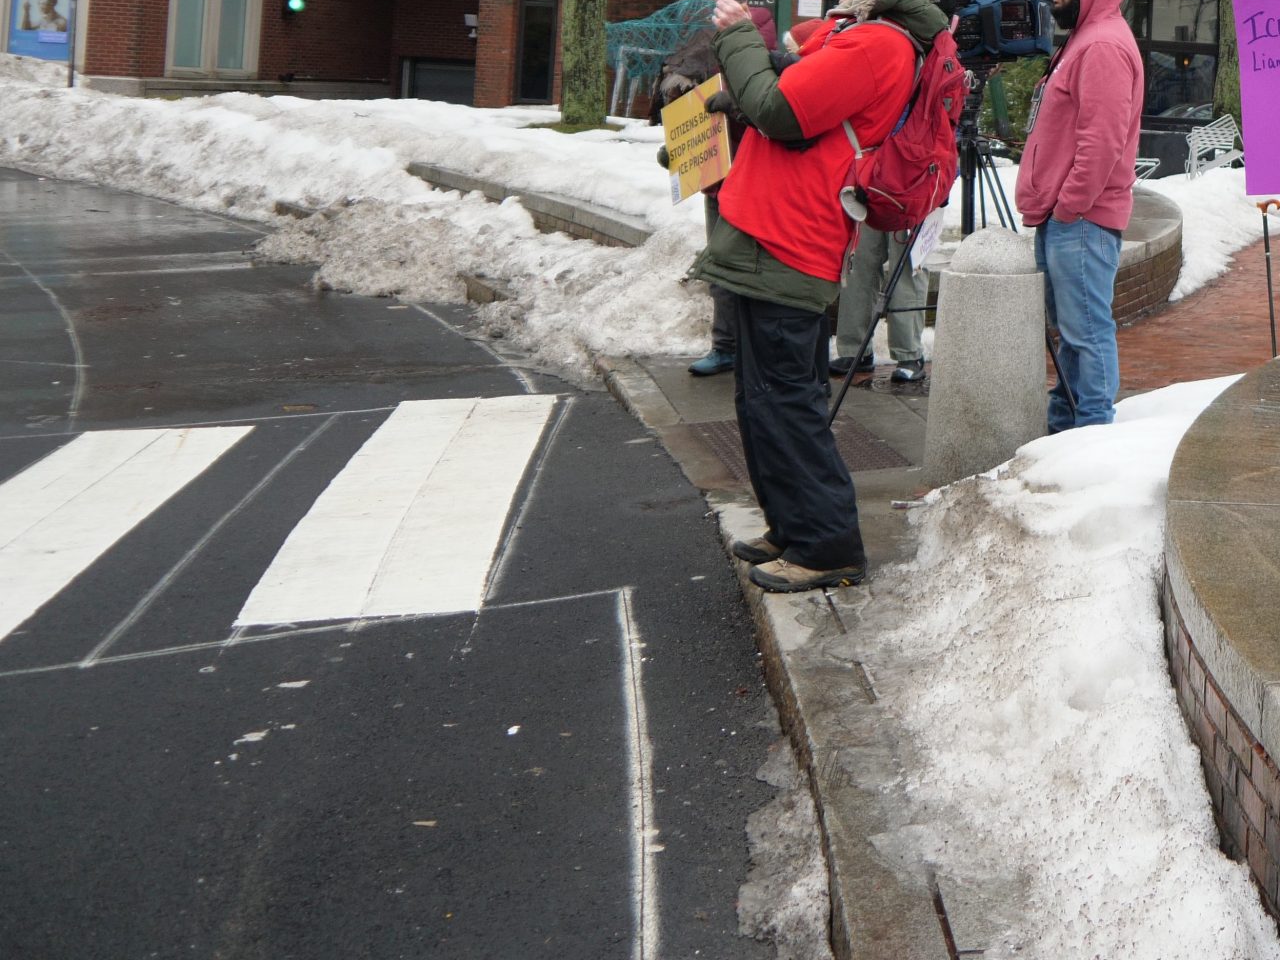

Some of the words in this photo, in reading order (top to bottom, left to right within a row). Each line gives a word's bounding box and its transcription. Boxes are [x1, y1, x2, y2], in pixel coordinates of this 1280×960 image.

[669, 144, 686, 161] STOP
[687, 122, 722, 152] FINANCING
[670, 116, 698, 141] CITIZENS
[678, 161, 689, 176] ICE
[689, 145, 718, 169] PRISONS
